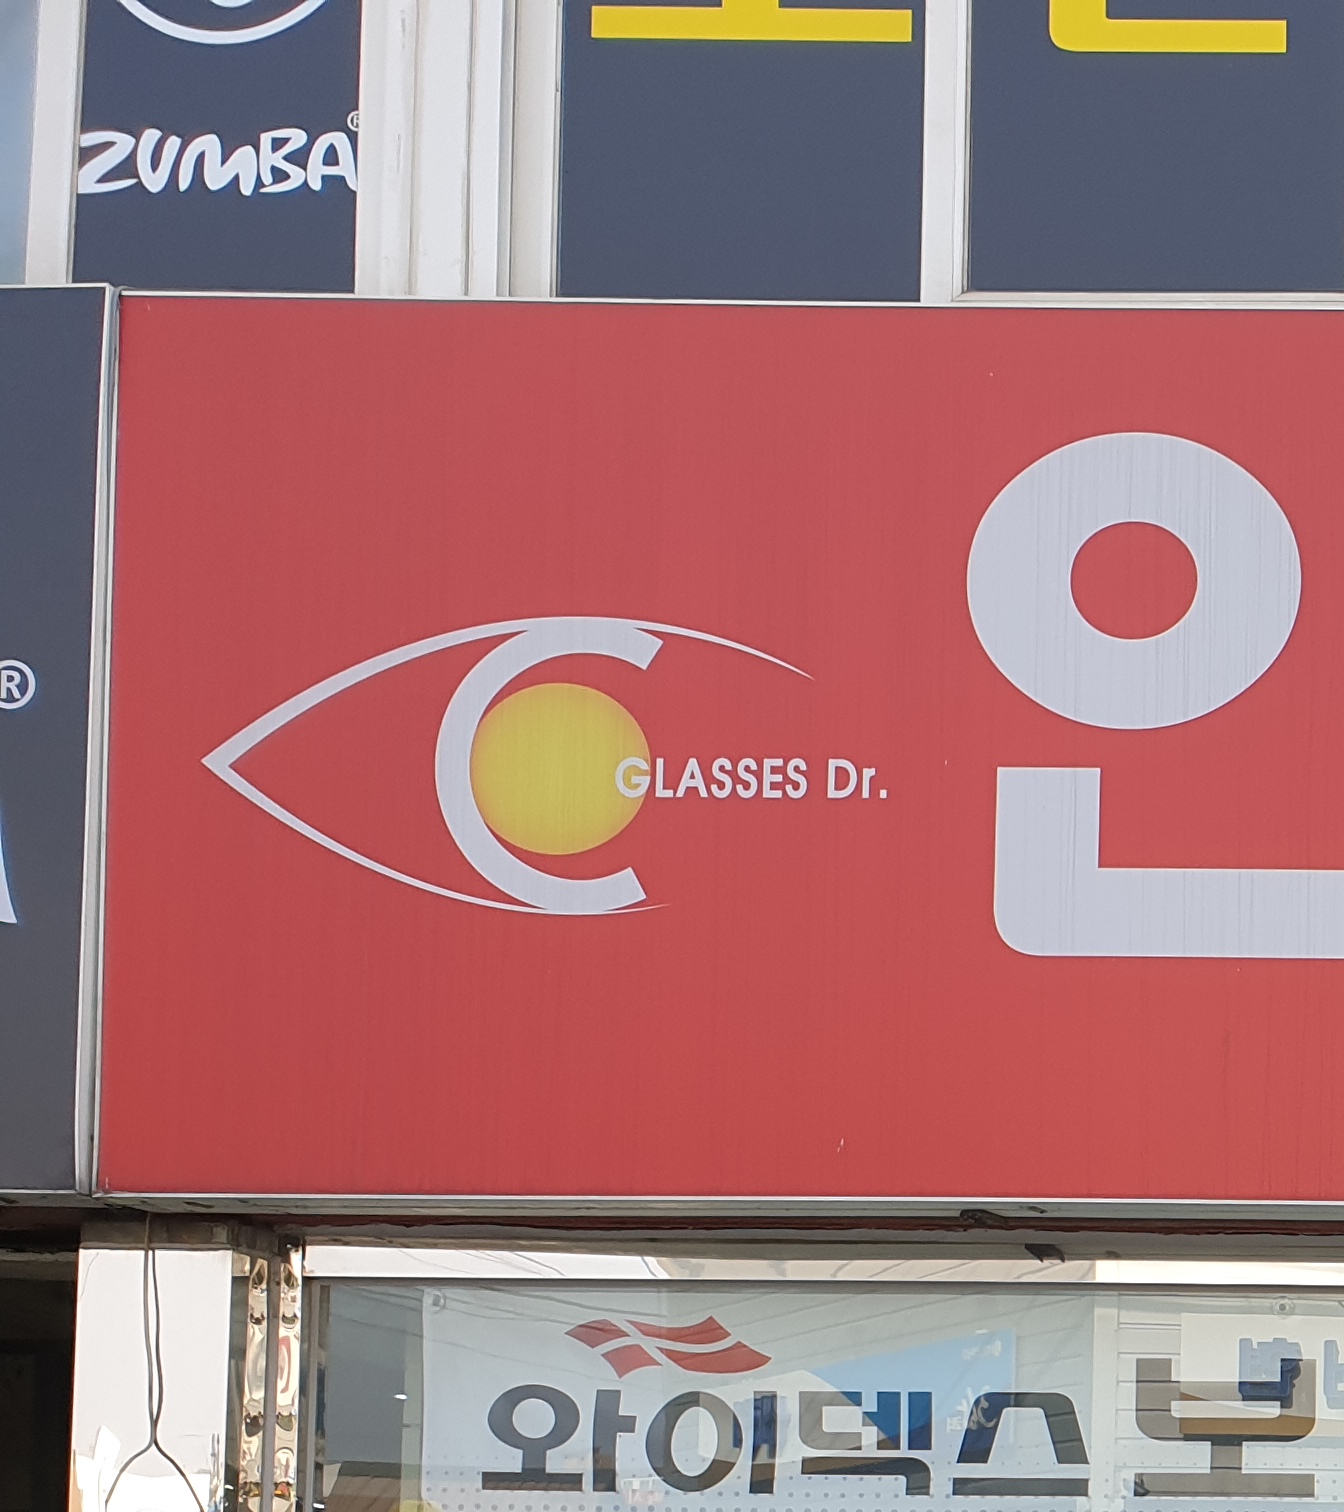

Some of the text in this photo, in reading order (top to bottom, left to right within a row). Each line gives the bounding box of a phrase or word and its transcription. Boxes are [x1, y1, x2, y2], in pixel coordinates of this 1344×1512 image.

[78, 127, 359, 197] ZUMBA
[614, 757, 889, 800] GLASSES Dr.
[481, 1384, 1090, 1497] 와이덱스
